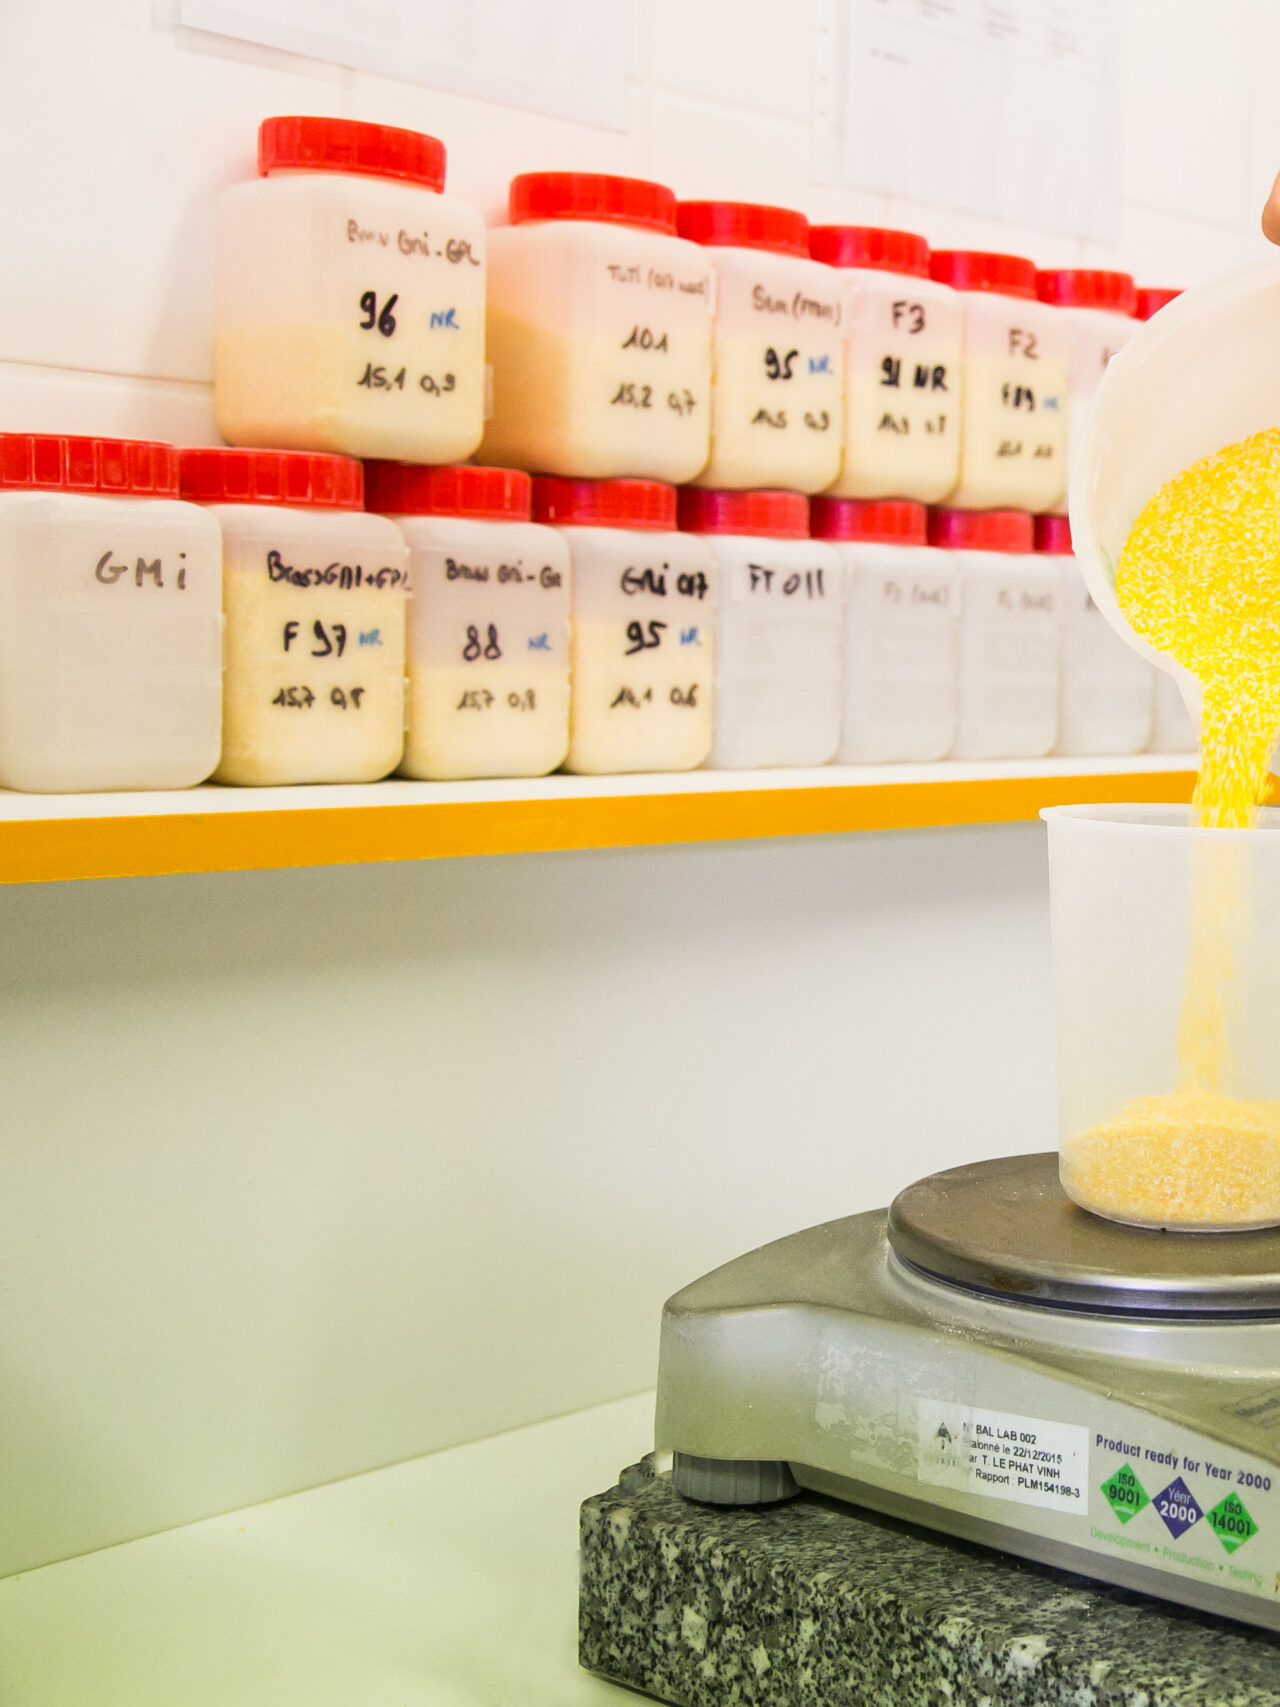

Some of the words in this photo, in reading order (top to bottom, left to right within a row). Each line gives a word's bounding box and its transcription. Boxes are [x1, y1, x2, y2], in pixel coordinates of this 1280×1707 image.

[360, 290, 398, 337] 96
[430, 308, 459, 329] NR
[892, 301, 926, 334] F3
[1008, 328, 1039, 361] F2
[765, 347, 799, 380] 95
[913, 365, 949, 391] NR
[283, 621, 299, 652] F
[463, 623, 502, 662] 88
[624, 621, 667, 655] 95
[976, 1424, 994, 1438] BAL
[997, 1428, 1017, 1441] LAB
[1020, 1432, 1037, 1445] 002
[982, 1455, 990, 1467] T.
[993, 1457, 1006, 1469] LE
[1008, 1460, 1034, 1475] PHAT
[1037, 1465, 1060, 1479] VINH
[1002, 1444, 1011, 1455] le
[1013, 1446, 1063, 1465] 22/12/2015
[1096, 1434, 1141, 1458] Product
[1145, 1448, 1179, 1470] ready
[1183, 1456, 1200, 1474] for
[1205, 1461, 1233, 1481] Year
[1237, 1470, 1271, 1491] 2000
[975, 1468, 1010, 1485] Rapport
[1017, 1476, 1080, 1498] PLM154198-3
[1118, 1472, 1135, 1487] ISO
[1109, 1484, 1140, 1506] 9001
[1168, 1487, 1192, 1505] Year
[1224, 1500, 1243, 1516] ISO
[1160, 1500, 1197, 1524] 2000
[1211, 1512, 1251, 1536] 14001
[1090, 1526, 1151, 1553] Development
[1162, 1546, 1215, 1570] Production
[1228, 1565, 1263, 1588] Testing
